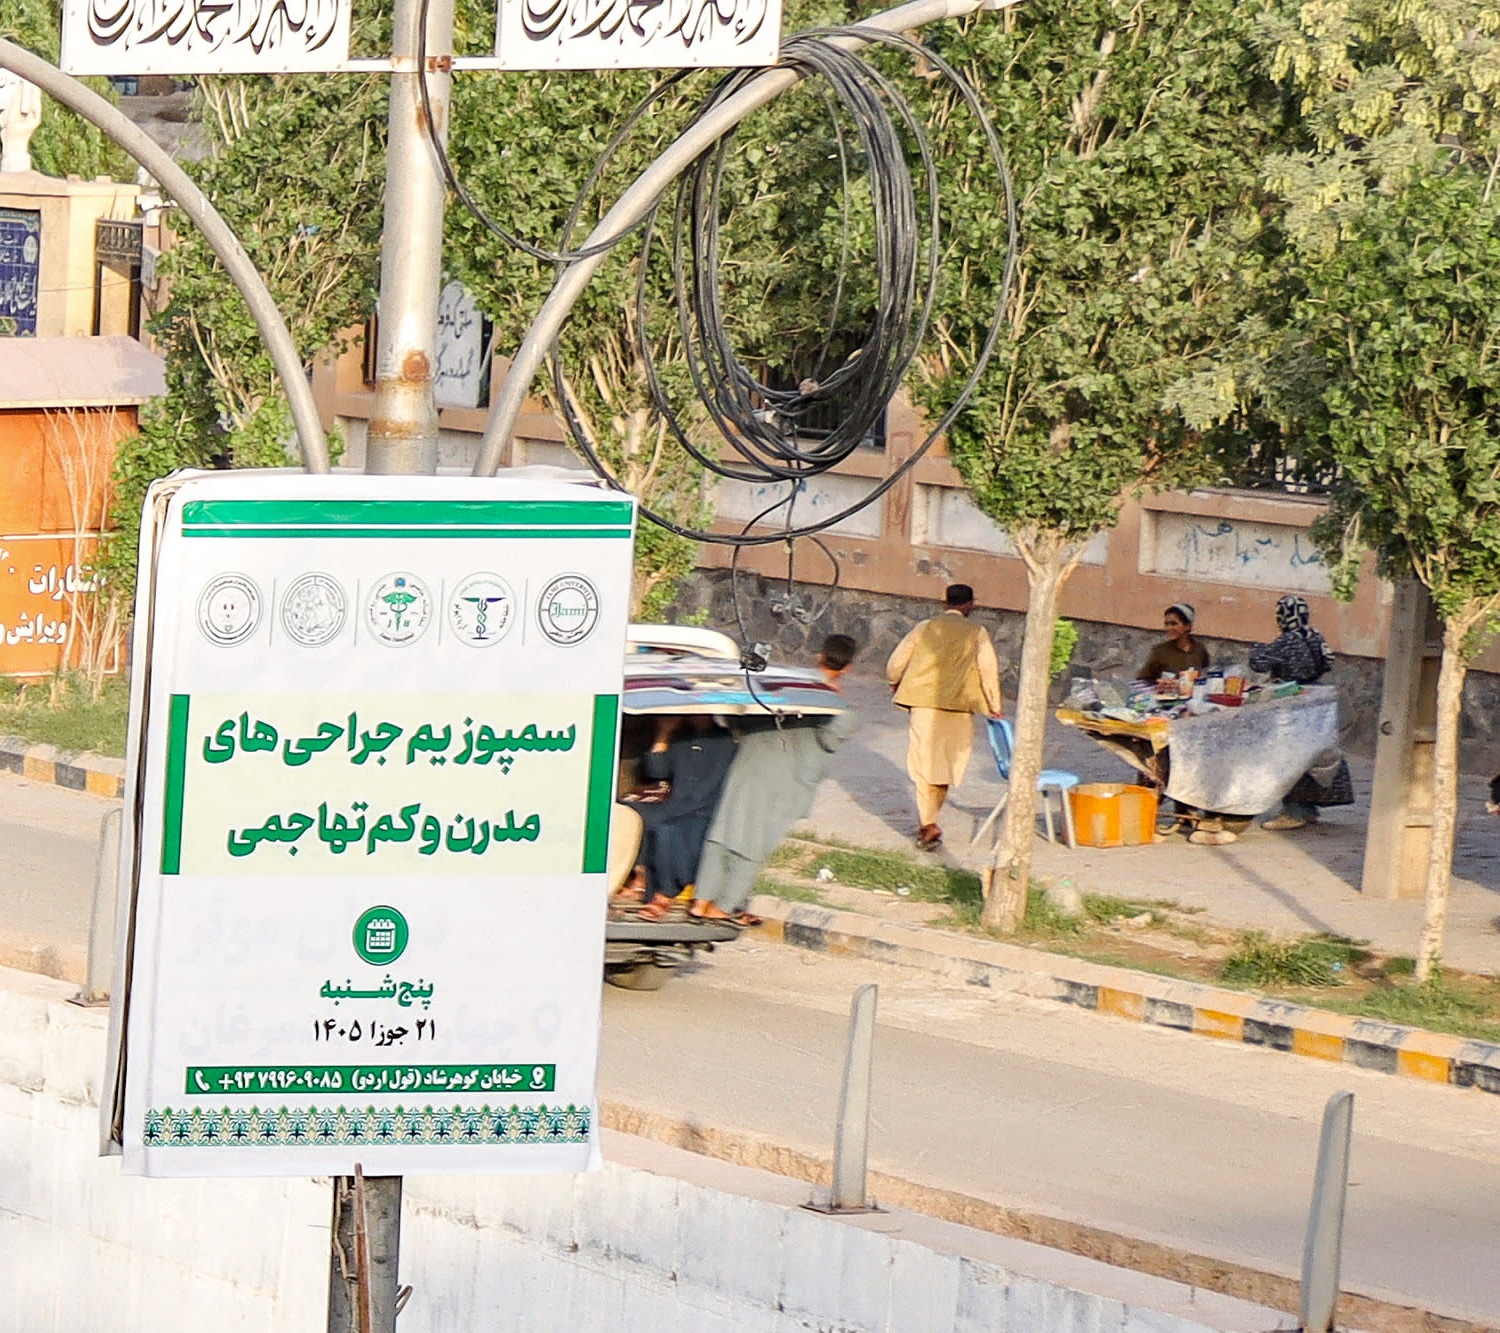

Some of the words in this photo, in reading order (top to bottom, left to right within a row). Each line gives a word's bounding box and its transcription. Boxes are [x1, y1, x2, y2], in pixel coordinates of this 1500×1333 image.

[551, 602, 586, 618] Jami
[5, 612, 68, 645] ویرایش
[202, 710, 278, 764] های
[282, 711, 404, 767] جراحی
[405, 716, 577, 775] سمپوزیم
[227, 801, 368, 857] تهاجمی
[445, 809, 541, 855] مدرن
[313, 1019, 362, 1042] ۱۴۰۵
[370, 1019, 409, 1046] جوزا
[415, 1019, 437, 1042] ۲۱
[351, 1068, 389, 1091] اردو)
[389, 1068, 422, 1090] (قول
[423, 1068, 479, 1090] گوهرشاد
[479, 1067, 523, 1090] خیابان
